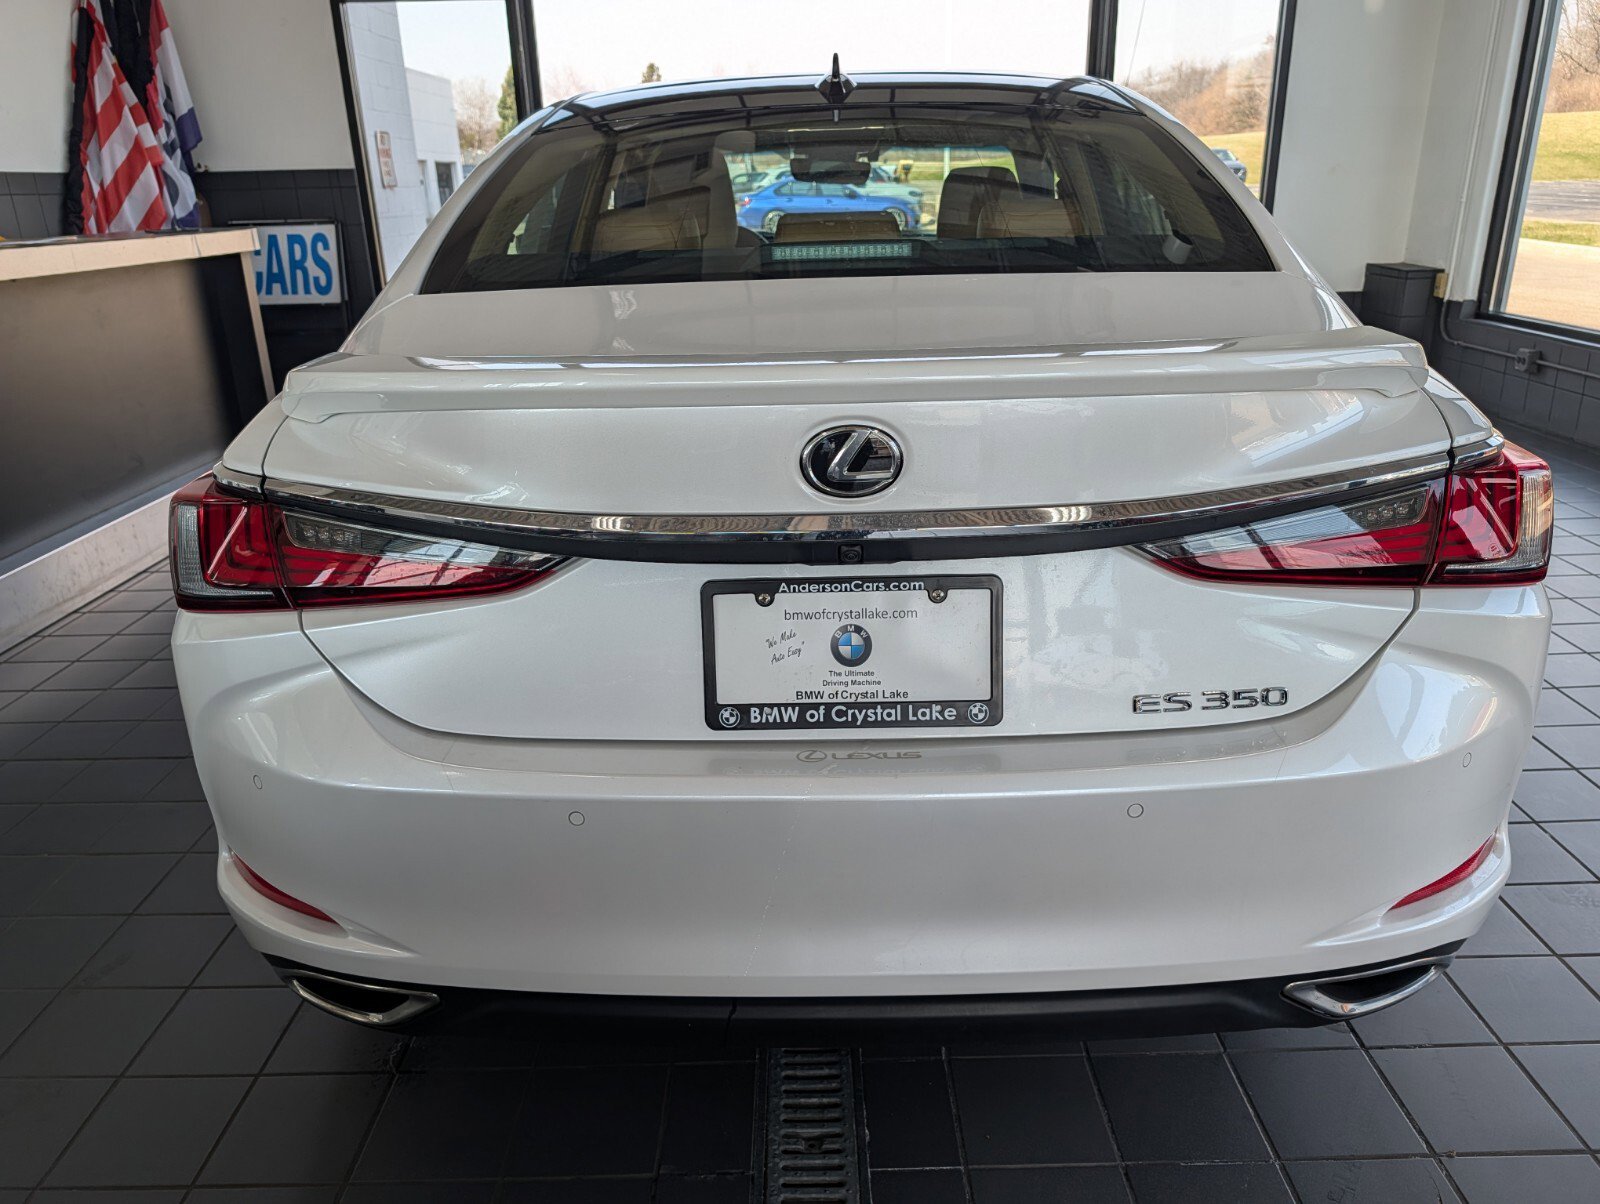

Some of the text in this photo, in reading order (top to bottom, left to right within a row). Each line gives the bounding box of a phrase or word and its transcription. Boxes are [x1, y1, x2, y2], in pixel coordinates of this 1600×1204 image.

[778, 580, 925, 593] AndersonCars.com
[784, 608, 918, 622] bmwofcrystallake.com
[796, 689, 909, 702] BMW of Crystal Lake
[1132, 686, 1289, 715] ES 350
[750, 707, 799, 724] BMW
[805, 707, 826, 723] of
[831, 705, 901, 726] Crystal
[908, 704, 957, 721] Lake
[831, 751, 922, 761] LEXUS
